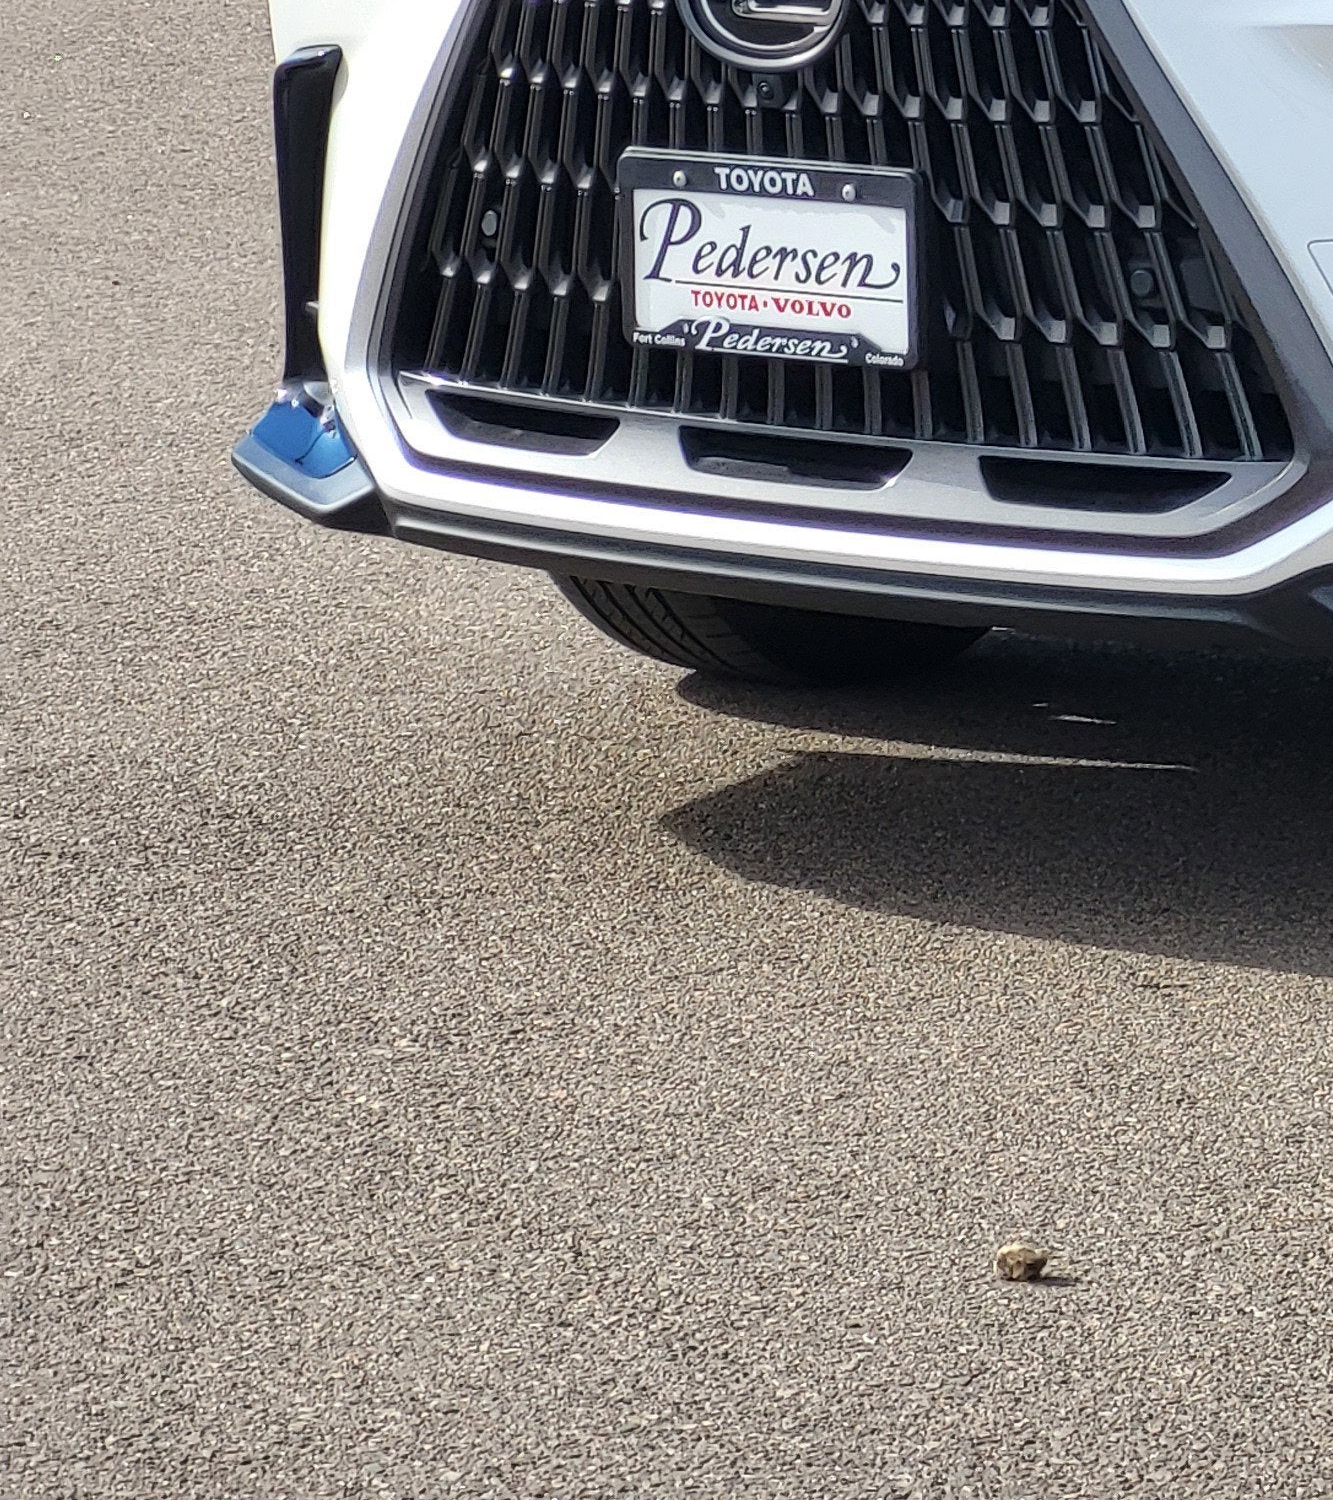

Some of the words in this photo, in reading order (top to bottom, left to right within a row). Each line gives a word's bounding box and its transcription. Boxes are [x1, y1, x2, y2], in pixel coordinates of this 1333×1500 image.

[714, 167, 815, 198] TOYOTA
[639, 197, 901, 290] Pedersen
[690, 289, 760, 313] TOYOTA
[770, 297, 852, 320] VOLVO
[690, 315, 849, 358] Pedersen
[865, 352, 904, 367] Colorado
